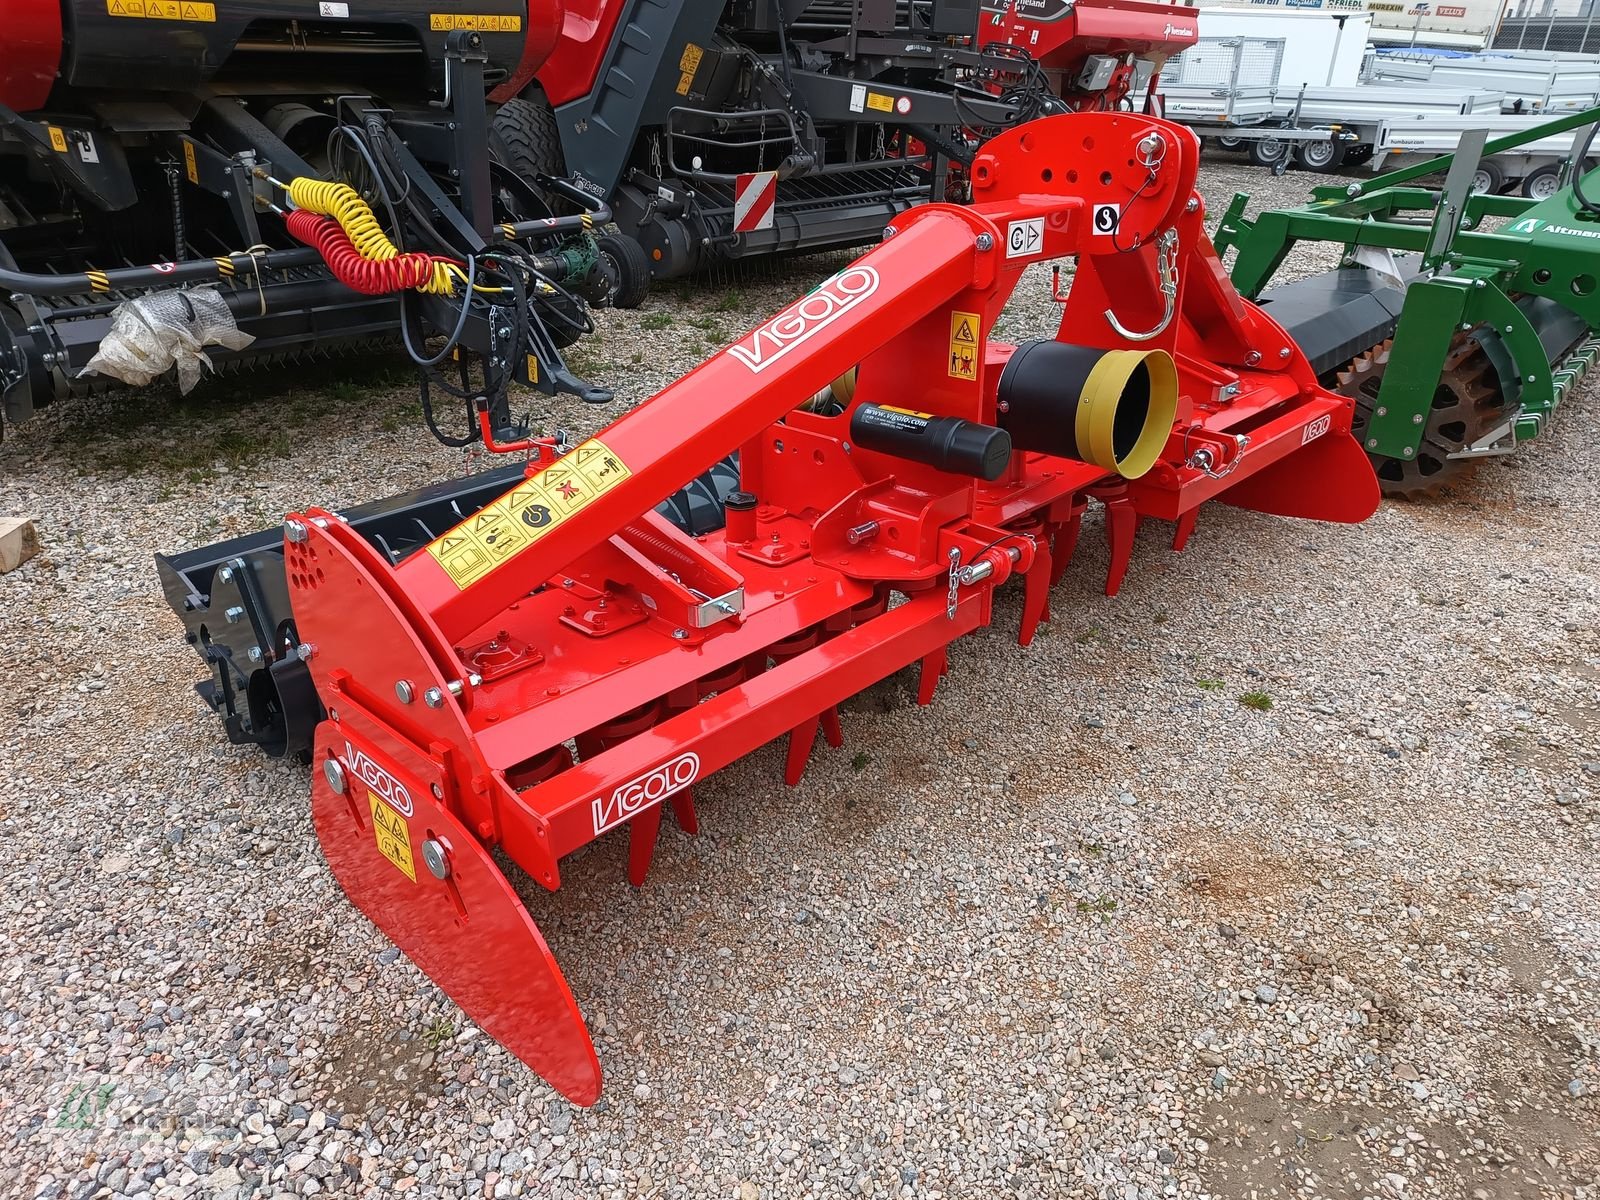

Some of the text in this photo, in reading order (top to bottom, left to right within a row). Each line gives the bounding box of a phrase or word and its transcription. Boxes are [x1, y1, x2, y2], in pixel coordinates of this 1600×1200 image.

[1368, 3, 1404, 12] MUREXIN
[1439, 8, 1464, 16] VELUX
[727, 266, 879, 372] VIGOLO
[864, 408, 928, 427] www.vigolo.com
[1302, 414, 1331, 446] VIGOLO
[345, 741, 414, 818] VIGOLO
[592, 752, 700, 836] VIGOLO
